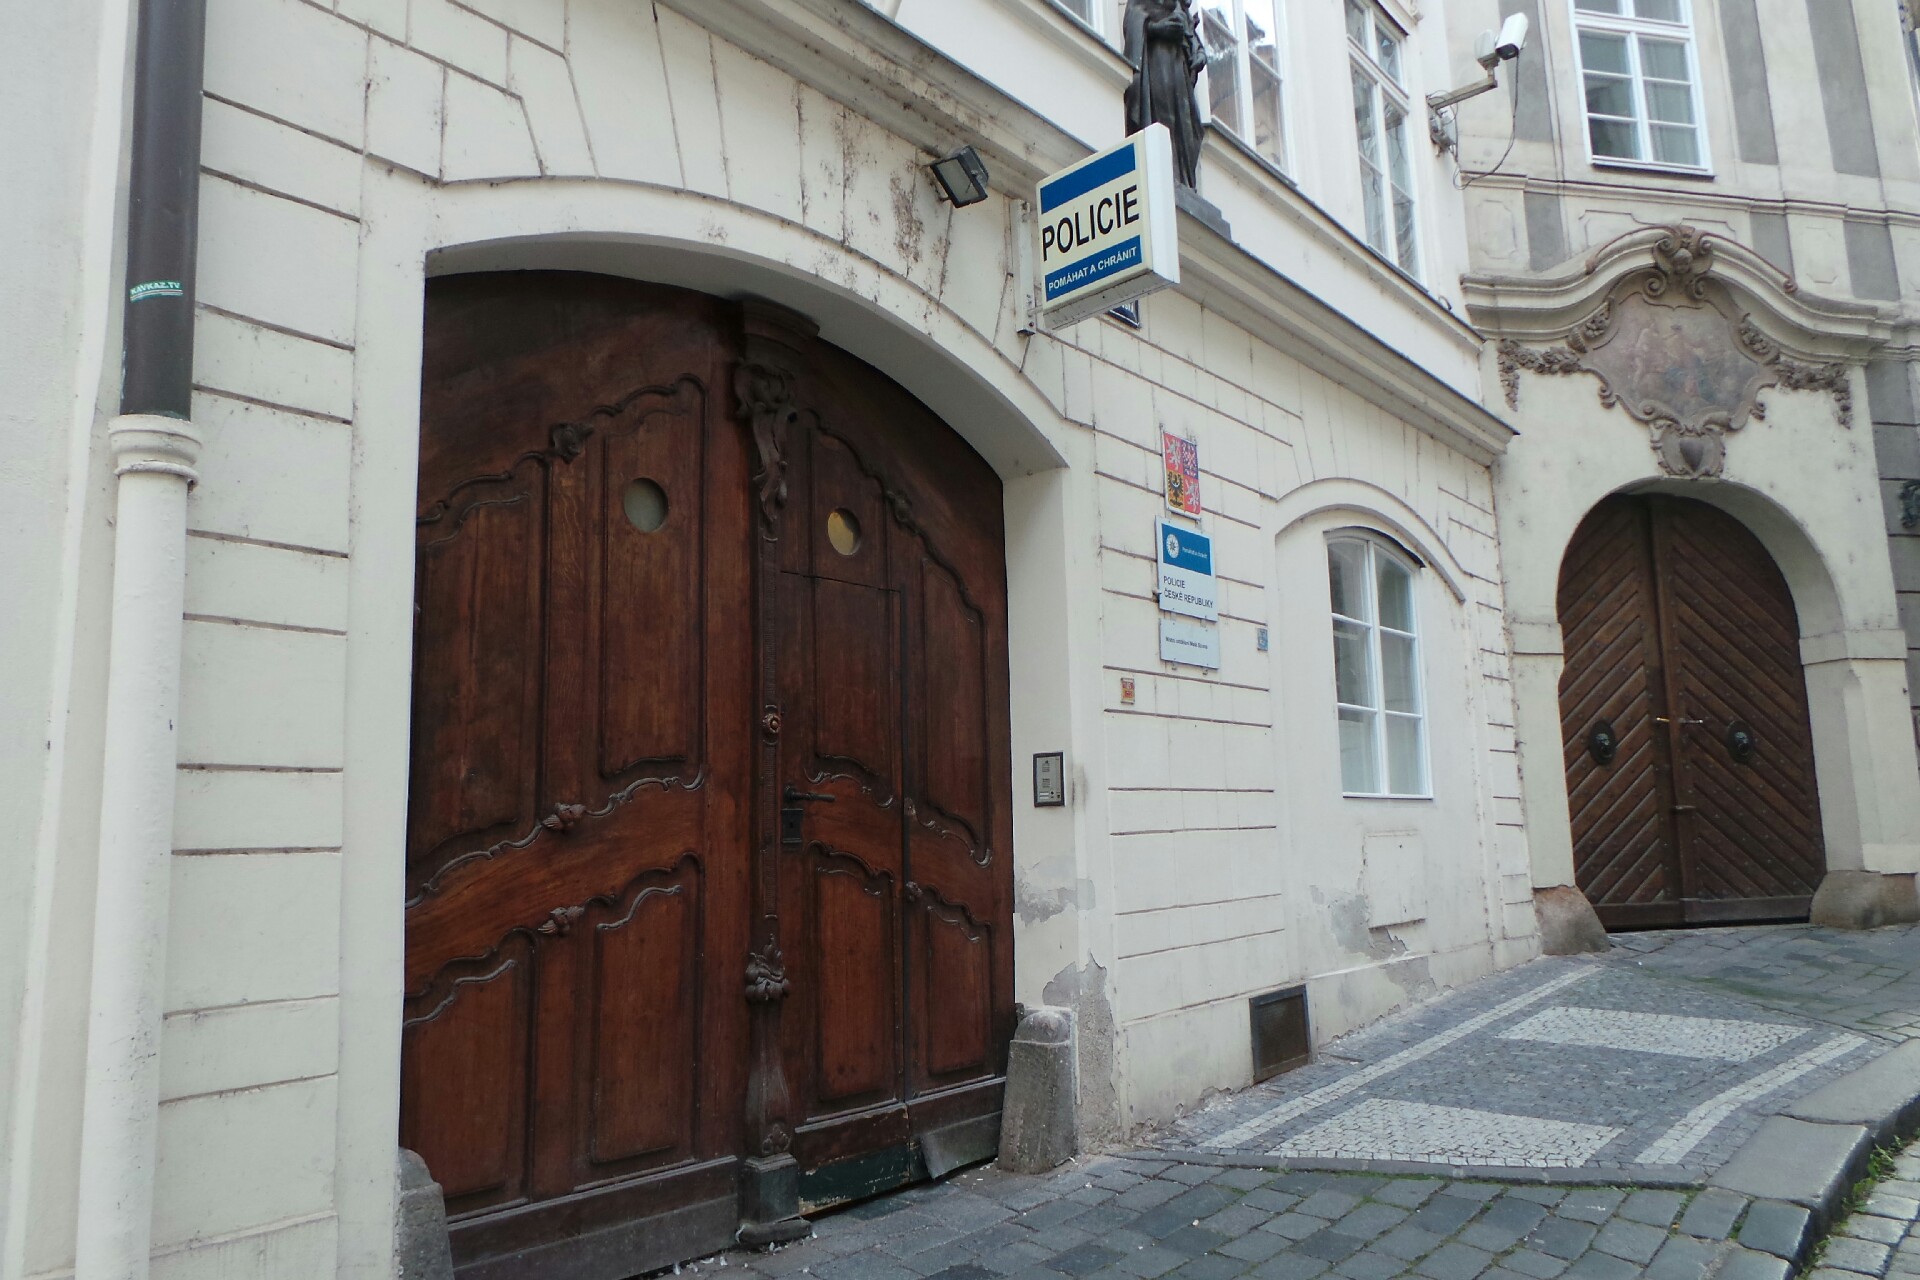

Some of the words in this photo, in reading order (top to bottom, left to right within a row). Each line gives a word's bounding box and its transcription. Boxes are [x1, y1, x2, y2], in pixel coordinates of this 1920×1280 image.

[1042, 184, 1140, 262] POLICIE
[1048, 267, 1088, 292] POMÁHAT
[1090, 264, 1097, 275] A
[1097, 246, 1137, 271] CHRÁNIT
[130, 281, 181, 295] KAVKAZ.TV
[1163, 575, 1186, 589] POLICIE
[1164, 587, 1183, 601] ČESKÉ
[1184, 594, 1214, 608] REPUBLIKY
